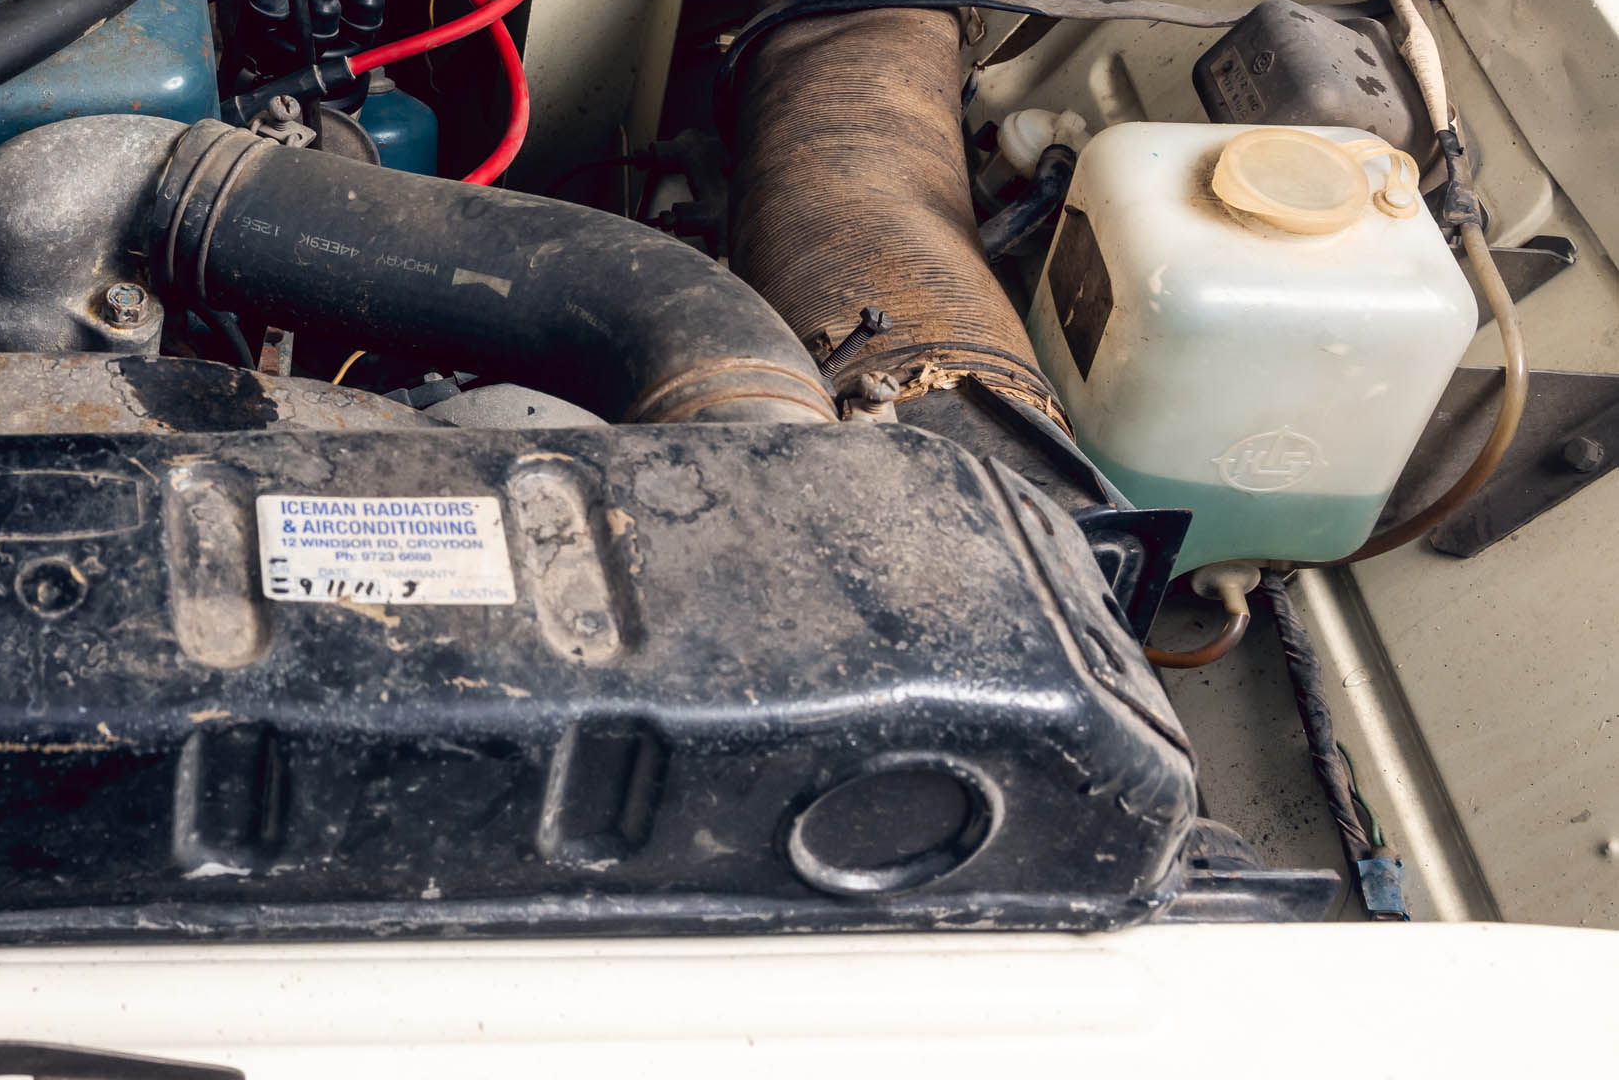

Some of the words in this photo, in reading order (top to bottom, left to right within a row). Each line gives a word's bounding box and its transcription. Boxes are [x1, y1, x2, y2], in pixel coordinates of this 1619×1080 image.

[374, 253, 438, 275] MACKAY
[281, 501, 356, 516] ICEMAN
[364, 502, 474, 517] RADIATORS
[283, 521, 297, 534] &
[303, 520, 477, 535] AIRCONDITIONING
[281, 538, 296, 547] 12
[300, 538, 373, 548] WINDSOR
[407, 539, 483, 549] CROYDON
[362, 552, 395, 561] 9723
